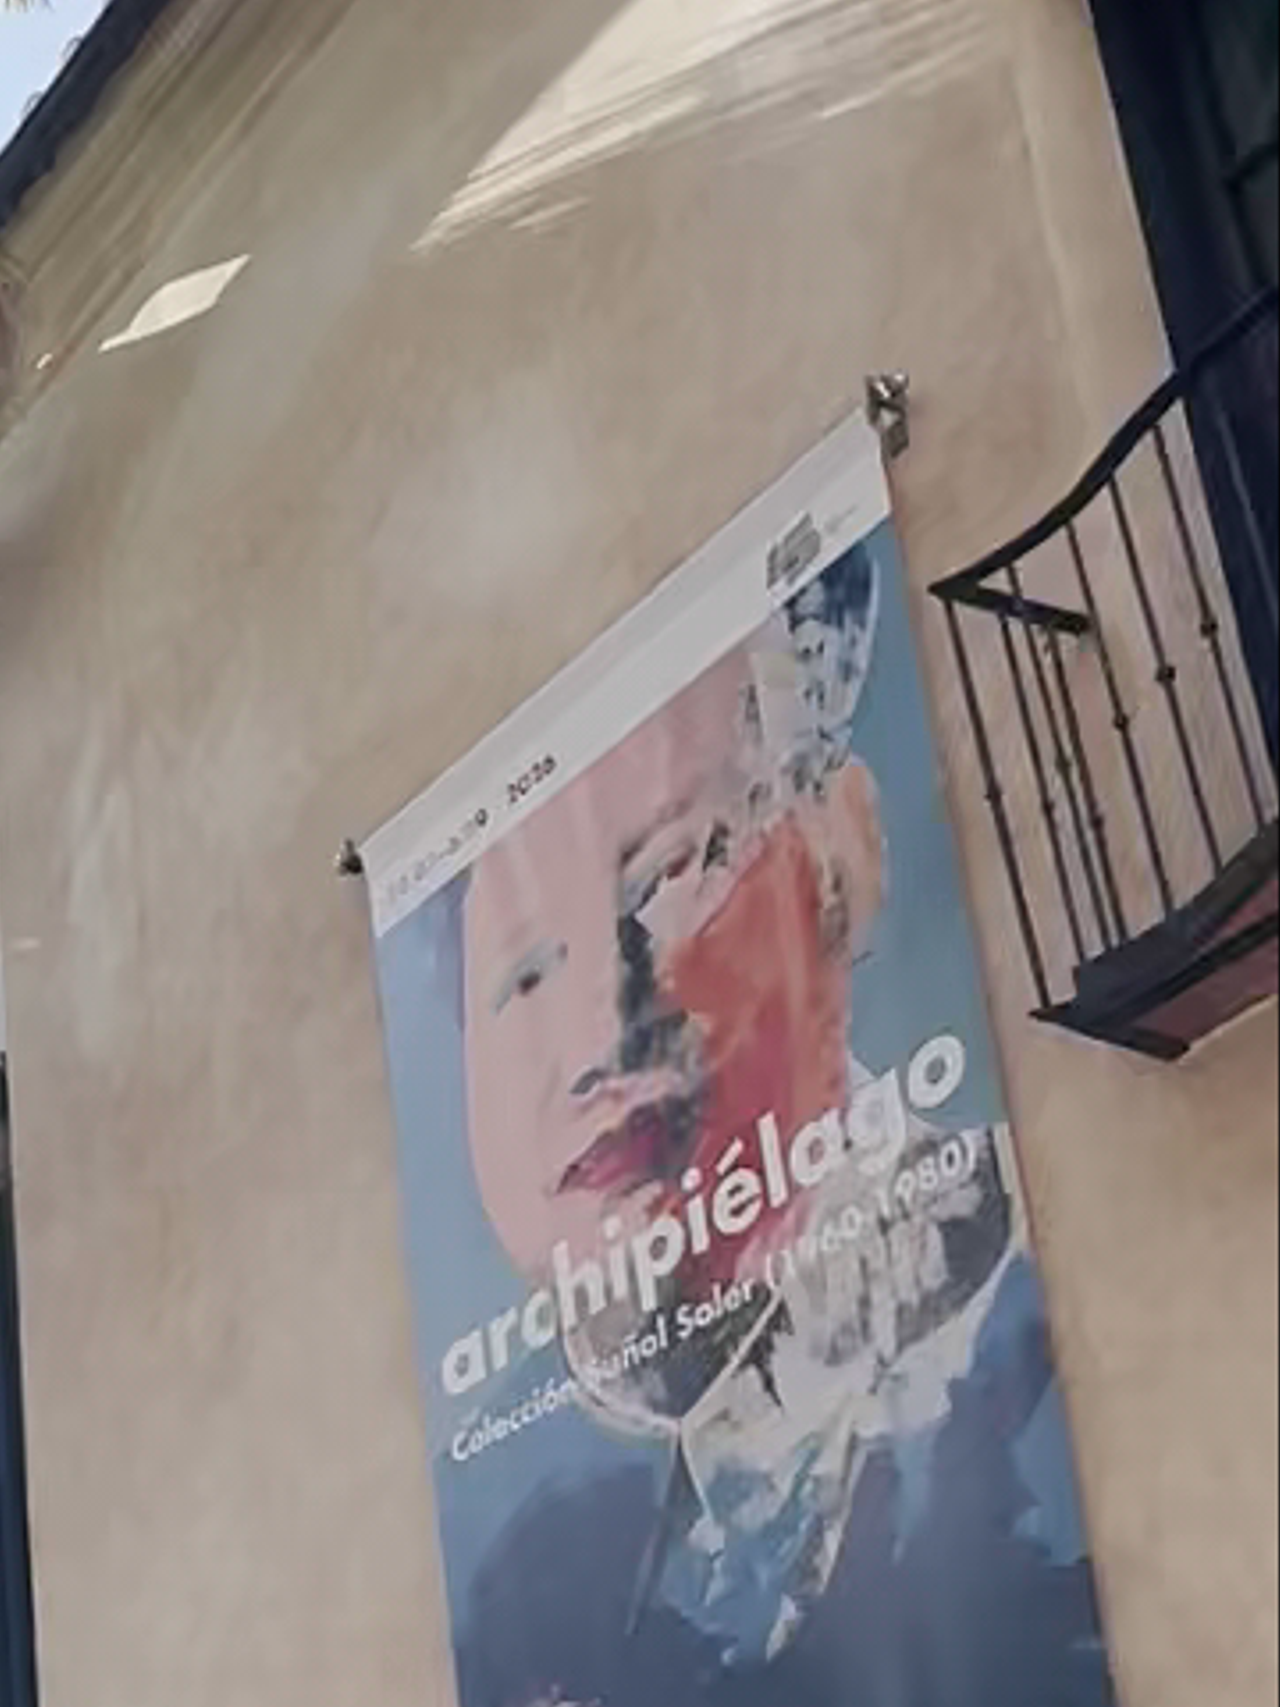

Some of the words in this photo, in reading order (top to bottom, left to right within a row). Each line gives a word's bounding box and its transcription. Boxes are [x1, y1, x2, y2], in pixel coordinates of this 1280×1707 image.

[442, 1035, 966, 1393] archipiélago
[451, 1377, 580, 1461] Colección
[766, 1130, 978, 1290] (1601980)
